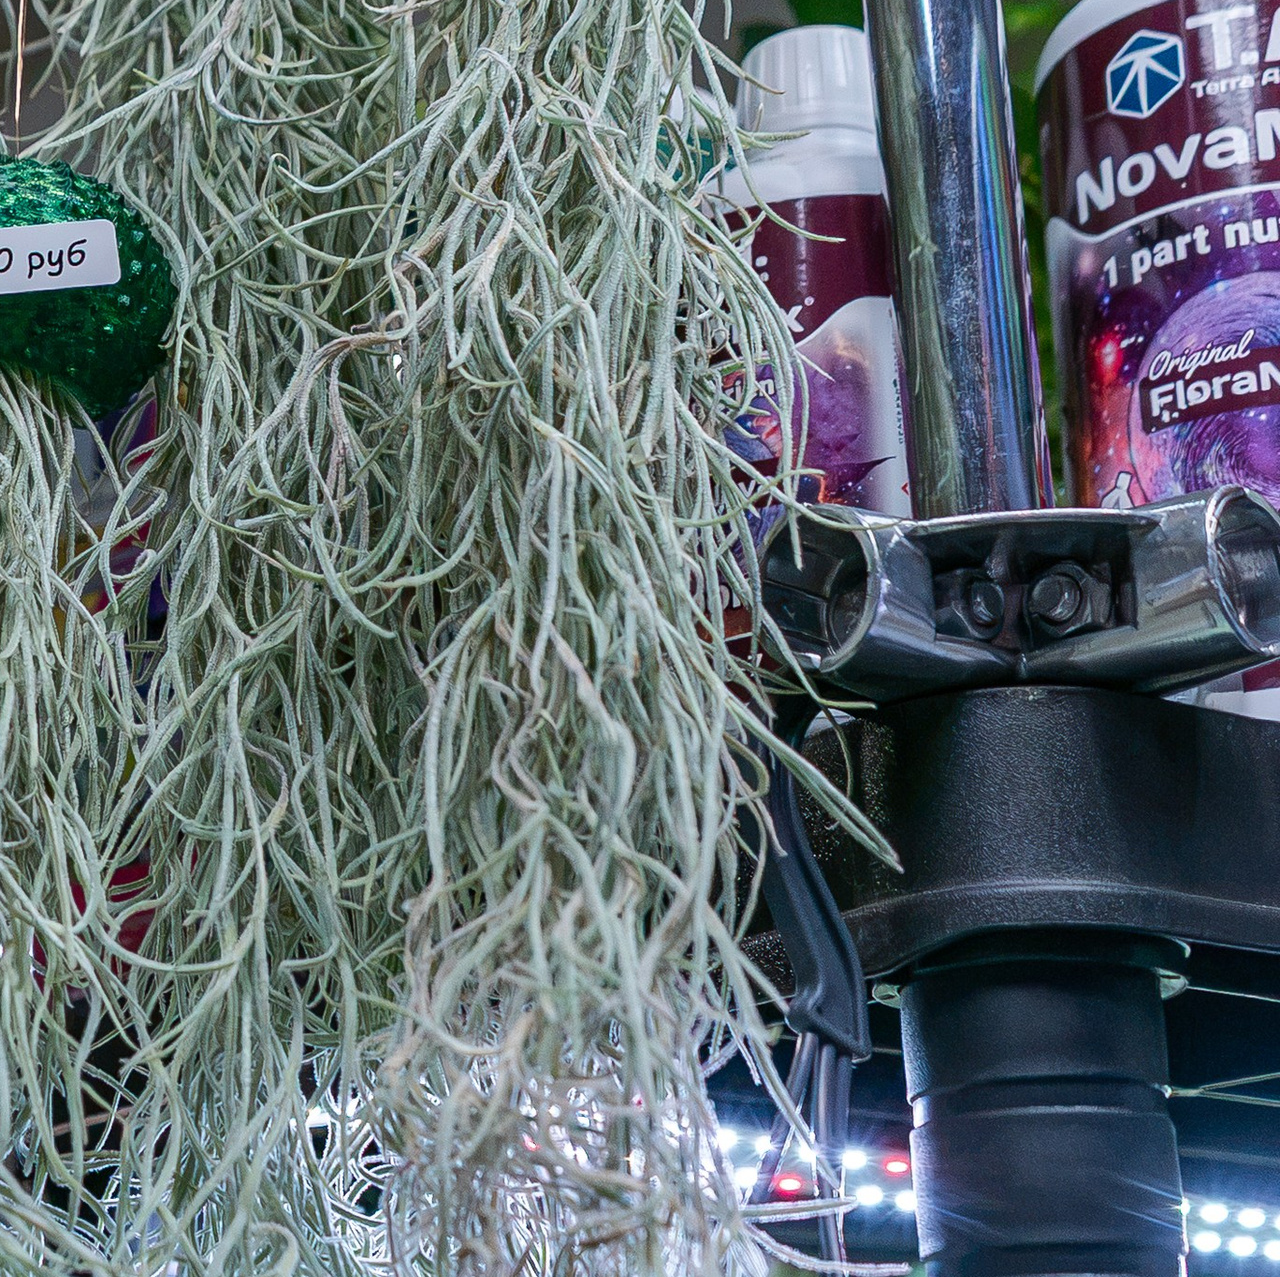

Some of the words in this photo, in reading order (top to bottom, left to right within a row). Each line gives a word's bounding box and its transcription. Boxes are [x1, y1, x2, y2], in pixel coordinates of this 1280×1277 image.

[27, 238, 88, 279] руб
[1103, 255, 1118, 288] 1
[1130, 224, 1212, 285] part
[1224, 216, 1280, 250] nu
[1148, 328, 1256, 380] Original
[1149, 360, 1280, 418] FloraN
